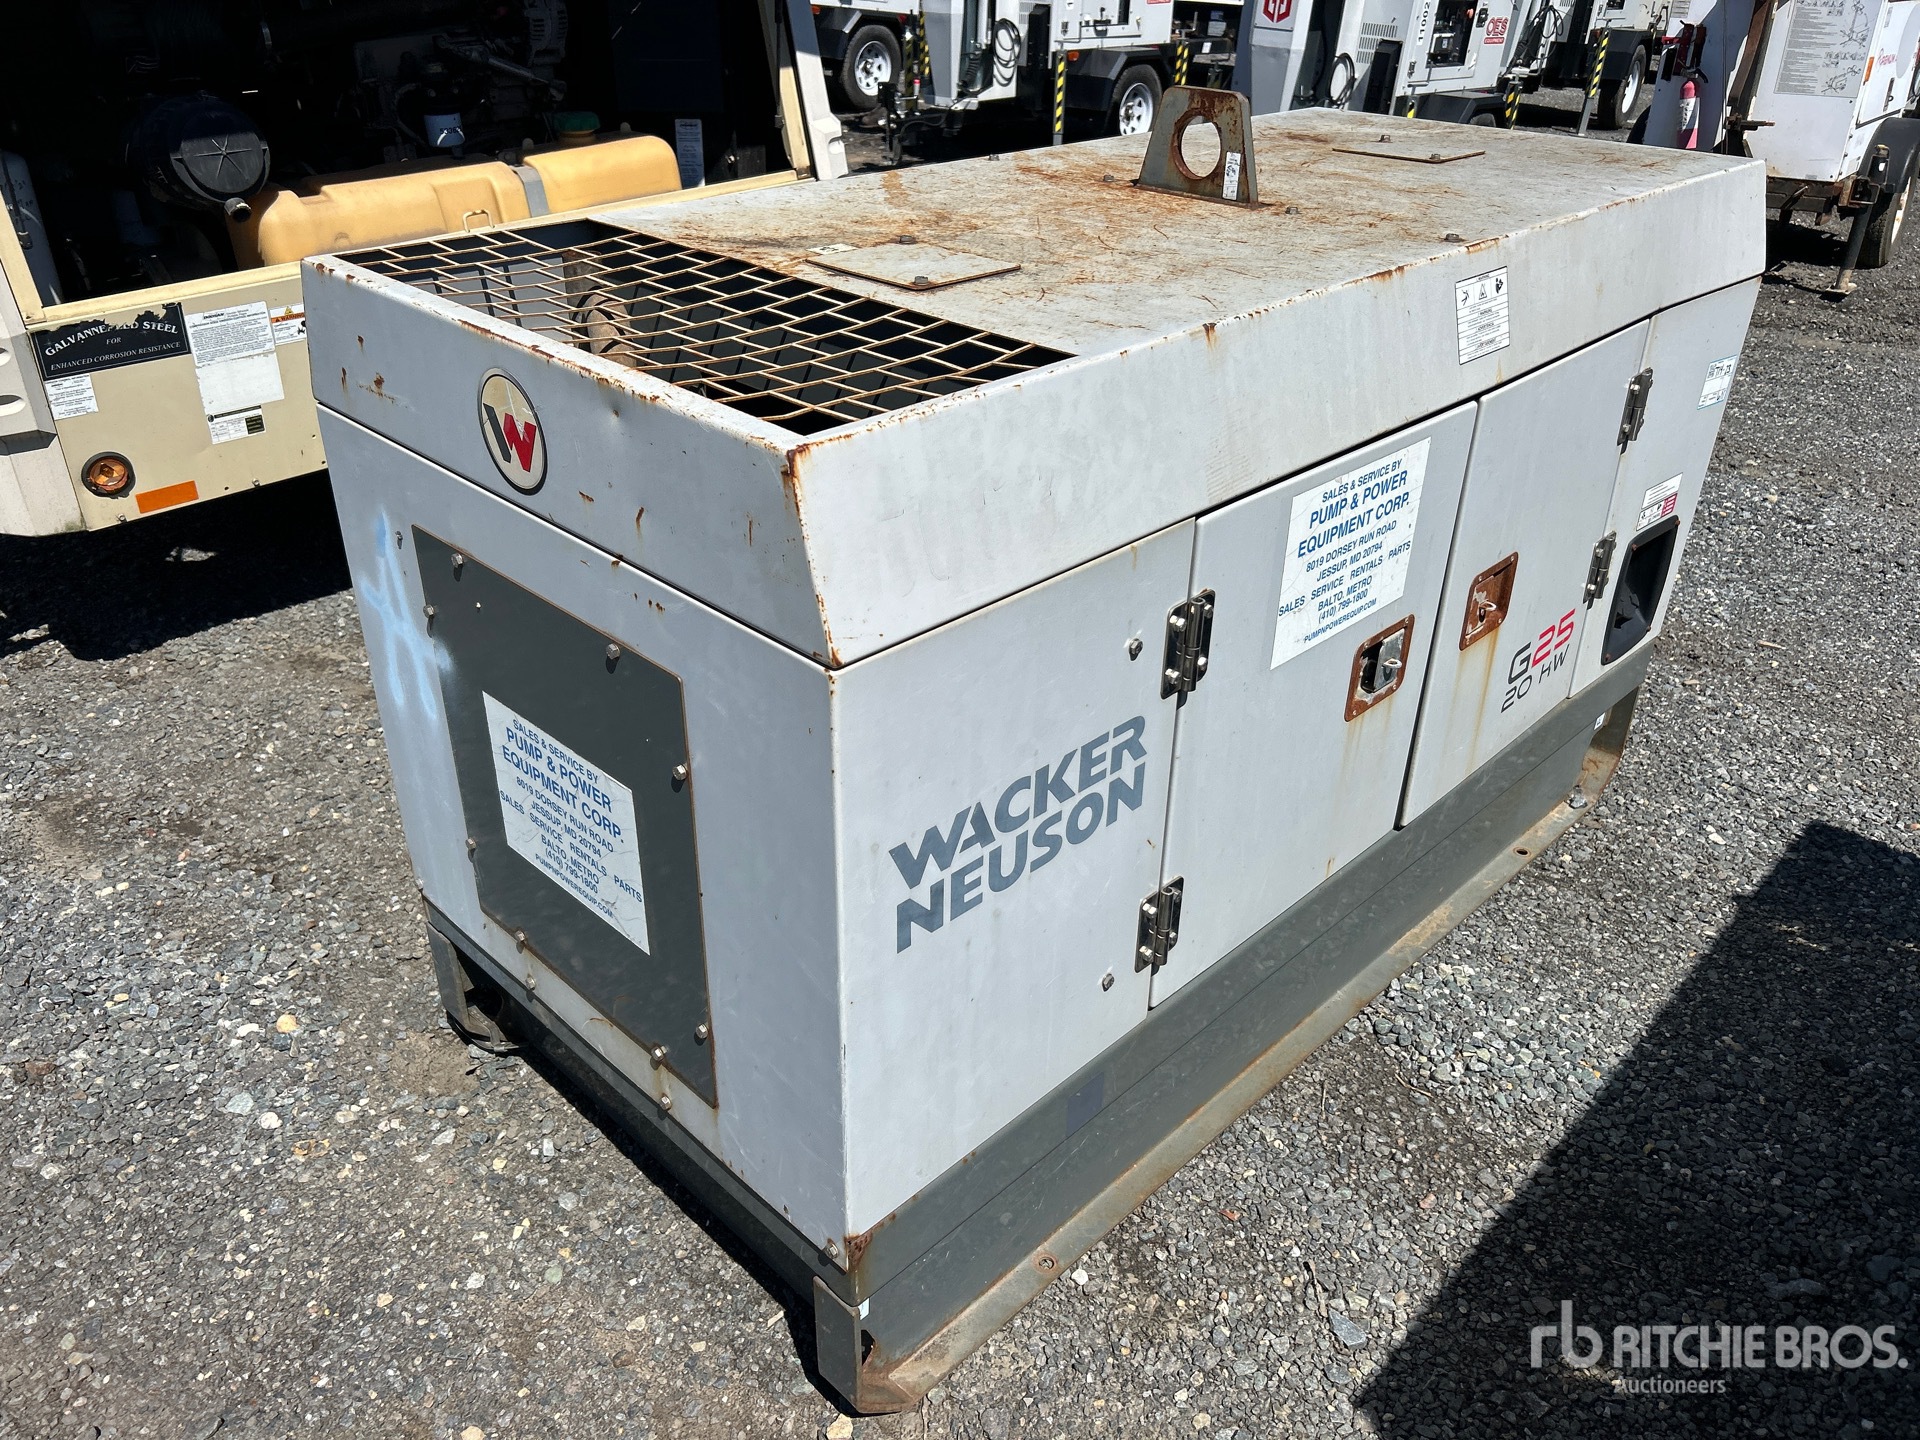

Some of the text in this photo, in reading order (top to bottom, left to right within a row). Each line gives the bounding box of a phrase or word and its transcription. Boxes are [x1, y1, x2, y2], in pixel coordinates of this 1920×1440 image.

[1487, 17, 1508, 36] OES
[45, 320, 178, 356] GALVANNEED STEEL
[50, 341, 181, 371] ENHANCED CORROSION RESISTANCE
[106, 337, 122, 345] FOR
[483, 402, 537, 473] W
[1309, 470, 1408, 529] PUMP & POWER
[1322, 458, 1403, 503] SALES & SERVICE BY
[1298, 491, 1410, 558] EQUIPMENT CORP.
[1306, 519, 1397, 572] 8019 DORSEY RUN ROAD
[1278, 540, 1411, 617] SALES SERVICE RENTALS PARTS
[1317, 541, 1383, 581] JESSUP, MD 20794
[1303, 598, 1377, 643] PUMPNPOWEREQUIP.COM
[1317, 575, 1373, 611] BALTO. METRO
[1318, 588, 1368, 624] (410) 799-1800
[1508, 608, 1576, 684] G25
[1501, 643, 1570, 713] 20 HW
[506, 726, 612, 813] PUMP & POWER
[513, 719, 599, 784] SALES & SERVICE BY
[502, 745, 624, 843] EQUIPMENT CORP.
[516, 776, 614, 853] 8019 DORSEY RUN ROAD
[888, 715, 1148, 890] WACKER
[500, 790, 643, 903] SALES SERVICE RENTALS PARTS
[531, 800, 602, 858] JESSUP, MD 20794
[897, 761, 1146, 954] NEUSON
[541, 834, 600, 884] BALTO. METRO
[545, 847, 598, 894] (410) 799-1800
